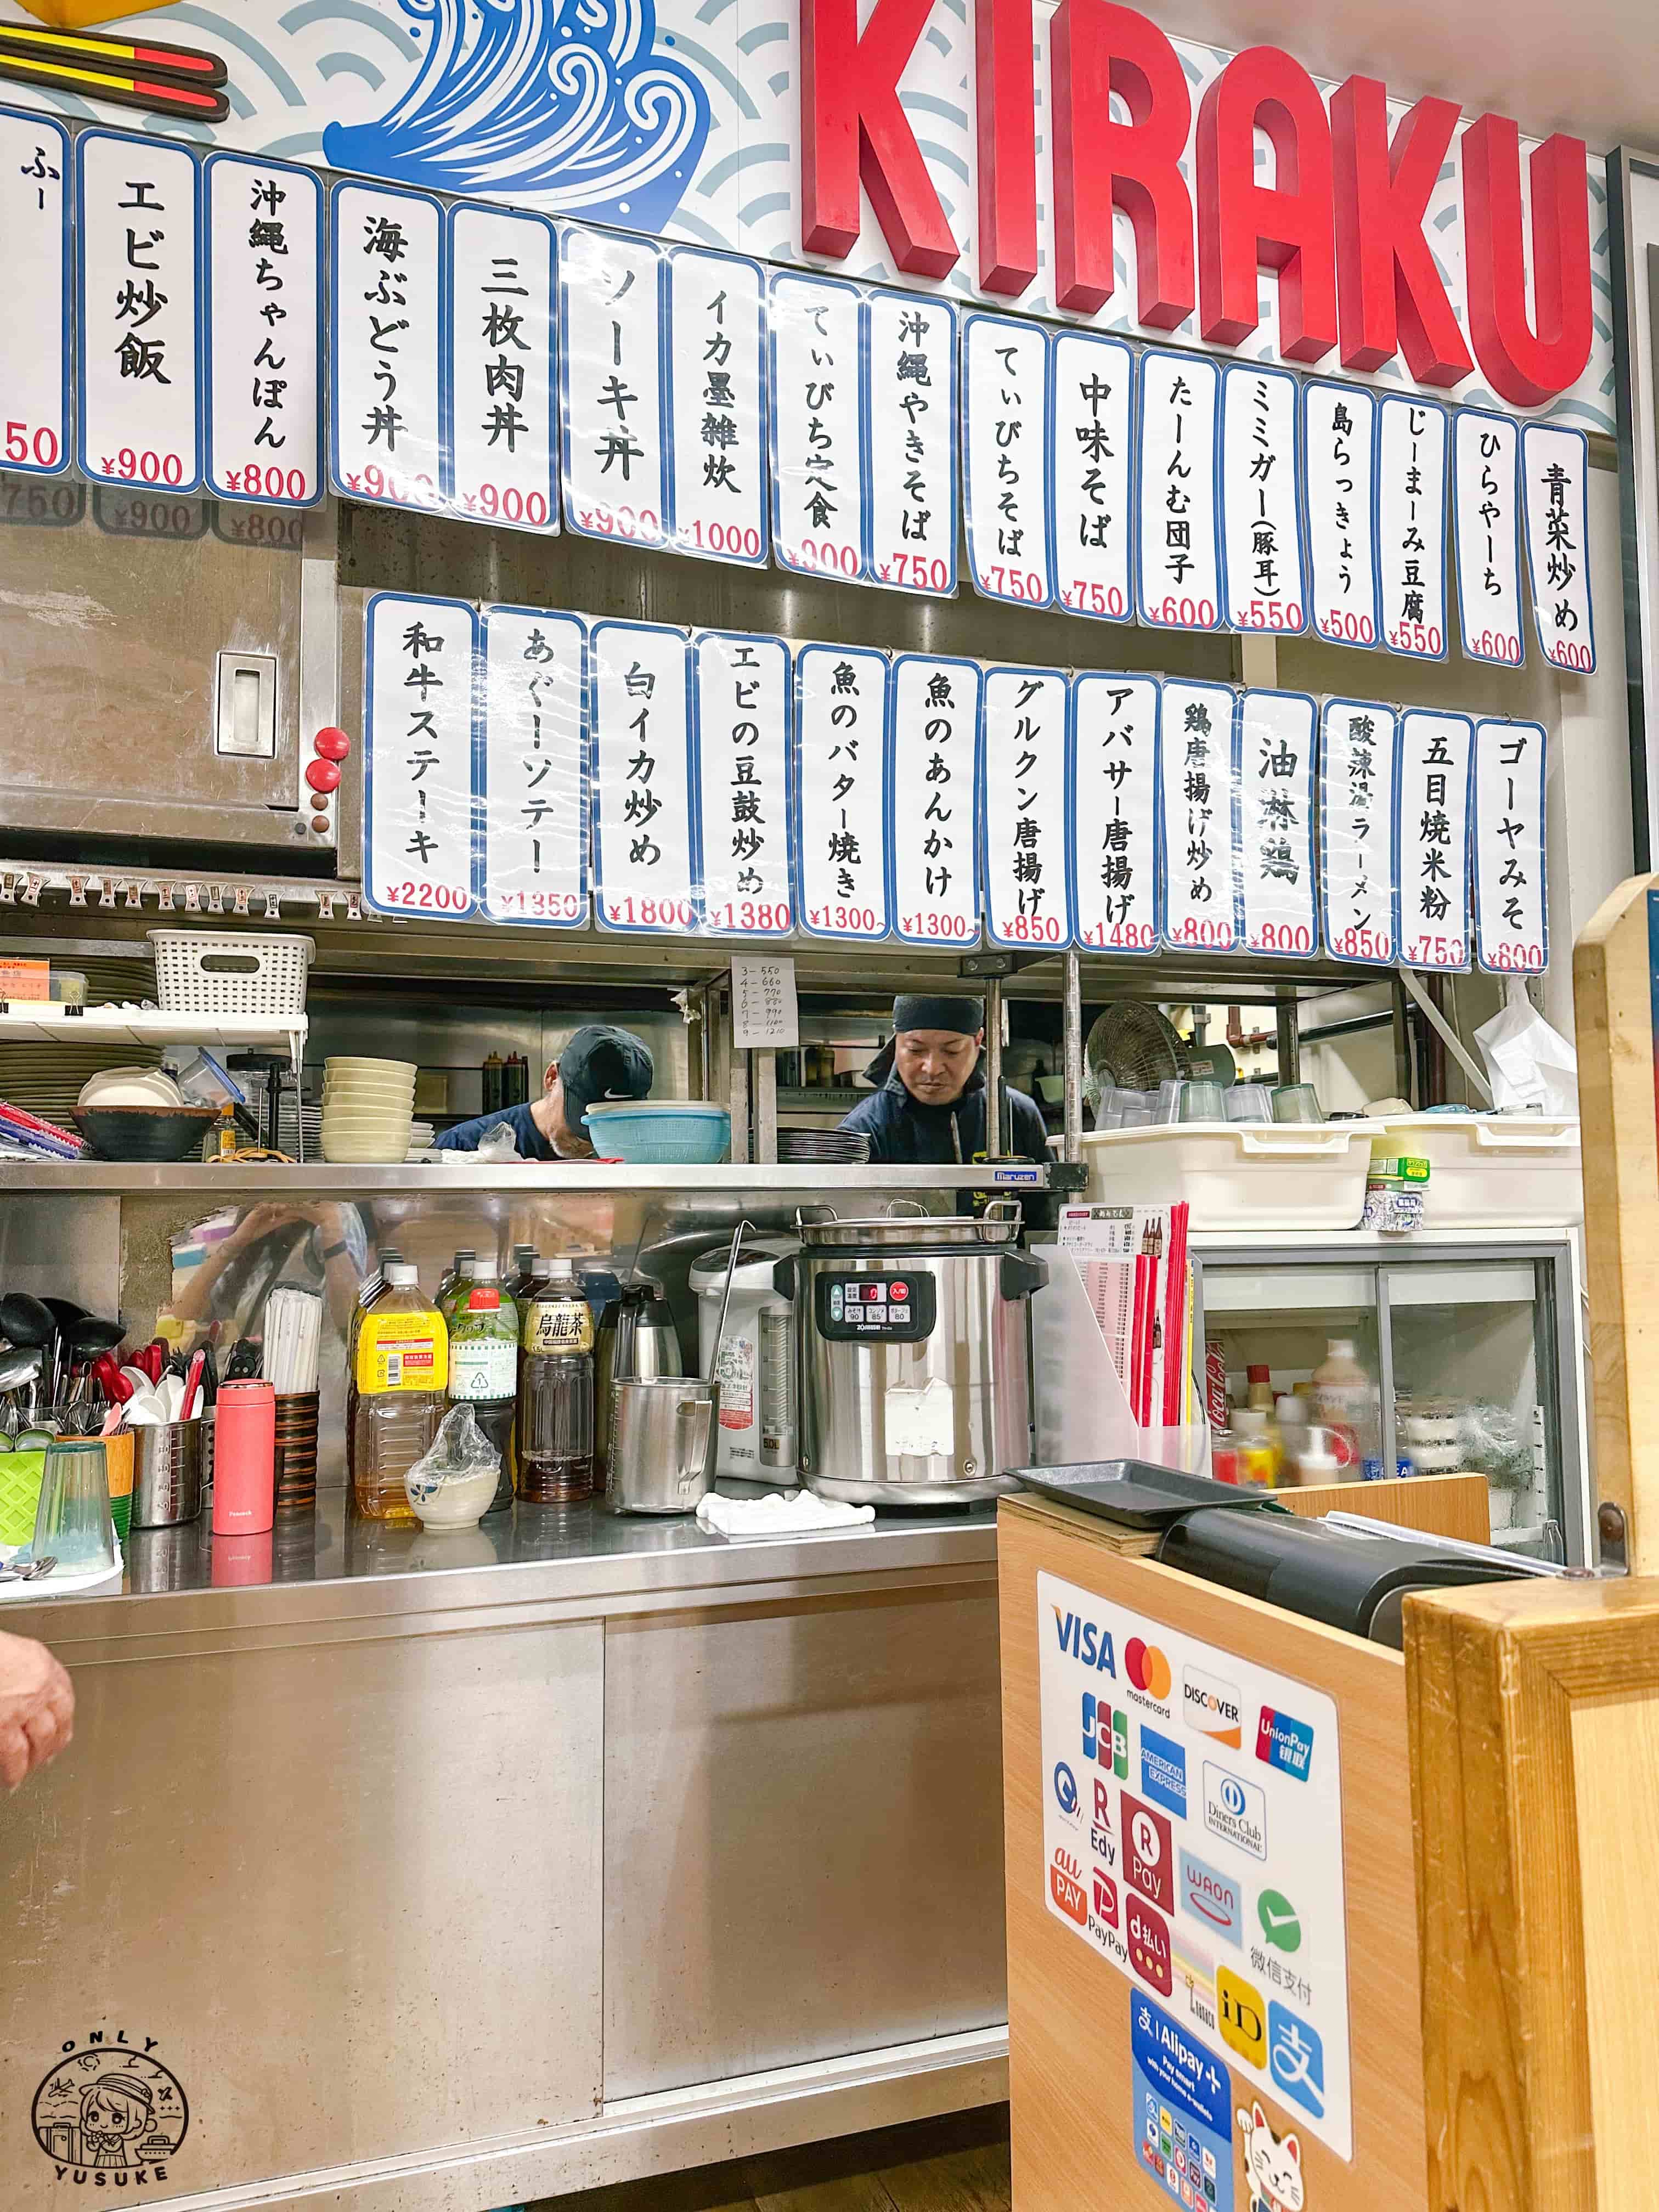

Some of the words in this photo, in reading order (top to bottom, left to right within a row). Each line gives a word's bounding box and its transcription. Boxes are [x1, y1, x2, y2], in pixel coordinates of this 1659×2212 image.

[801, 0, 1594, 406] KIRAKU
[115, 182, 171, 383] エビ炒飯
[249, 179, 288, 448] 沖縄ちゃんぽん
[362, 216, 409, 451] 海ぶどう丼
[481, 259, 531, 452] 三枚肉丼
[594, 270, 645, 481] ソーキ丼
[701, 291, 741, 493] イカ墨雑炊
[897, 312, 931, 540] 沖縄やきそば
[103, 448, 182, 484] ¥900
[1076, 373, 1114, 548] 中味そば
[1165, 376, 1194, 584] たーんむ団子
[227, 464, 306, 500] ¥800
[1333, 402, 1352, 593] 島らっきょう
[463, 483, 547, 526] ¥900
[1401, 407, 1425, 624] じーまーみ豆腐
[1479, 433, 1501, 595] ひらやーち
[678, 520, 759, 556] ¥1000
[1541, 463, 1578, 631] 青菜炒め
[879, 553, 947, 591] ¥750
[980, 566, 1042, 603] ¥750
[1065, 580, 1122, 616] ¥750
[1151, 597, 1214, 628] ¥600
[1240, 600, 1302, 630] ¥550
[1323, 610, 1373, 642] ¥500
[1392, 622, 1441, 653] ¥550
[1474, 630, 1519, 662] ¥600
[1551, 641, 1590, 670] ¥600
[403, 622, 444, 863] 和牛ステーキ
[521, 629, 554, 873] あぐーソテー
[624, 662, 662, 865] 白イカ炒め
[828, 662, 861, 898] 魚のバター焼き
[924, 673, 955, 896] 魚のあんかけ
[1013, 680, 1045, 916] グルクン唐揚げ
[1184, 703, 1212, 902] 鶏唐揚げ炒め
[1101, 689, 1135, 924] アバサー唐揚げ
[1420, 737, 1454, 921] 五目焼米粉
[1497, 738, 1527, 929] ゴーヤみそ
[388, 882, 466, 909] ¥2200
[611, 898, 691, 924] ¥1800
[710, 902, 791, 931] ¥1380
[1005, 916, 1059, 941] ¥850
[1086, 922, 1154, 948] ¥1480
[1175, 917, 1231, 948] ¥800
[1251, 923, 1310, 954] ¥800
[1336, 928, 1389, 958] ¥850
[1410, 936, 1462, 963] ¥750
[1488, 943, 1542, 972] ¥800
[760, 966, 779, 975] 550
[762, 977, 781, 986] 660
[764, 988, 781, 997] 770
[997, 1171, 1035, 1181] Maruzen
[536, 1312, 584, 1336] 烏龍茶
[1051, 1604, 1116, 1680] VISA
[1126, 1689, 1171, 1719] mastercard
[1184, 1684, 1239, 1723] DISCOVER
[1082, 1716, 1128, 1758] JCB
[1261, 1718, 1310, 1758] UnionPay
[1141, 1748, 1183, 1780] AMERICAN
[1149, 1768, 1187, 1797] EXPRESS
[1208, 1802, 1237, 1829] Diners
[1238, 1818, 1261, 1842] Club
[1208, 1817, 1262, 1852] INTERNATIONAL
[1091, 1827, 1115, 1866] Edy
[1056, 1876, 1081, 1905] PAY
[1133, 1856, 1162, 1900] Pay
[1088, 1914, 1127, 1963] PayPay
[1130, 1914, 1166, 1959] d払い
[1251, 1946, 1312, 2006] 微信支付
[1222, 1989, 1262, 2041] iD
